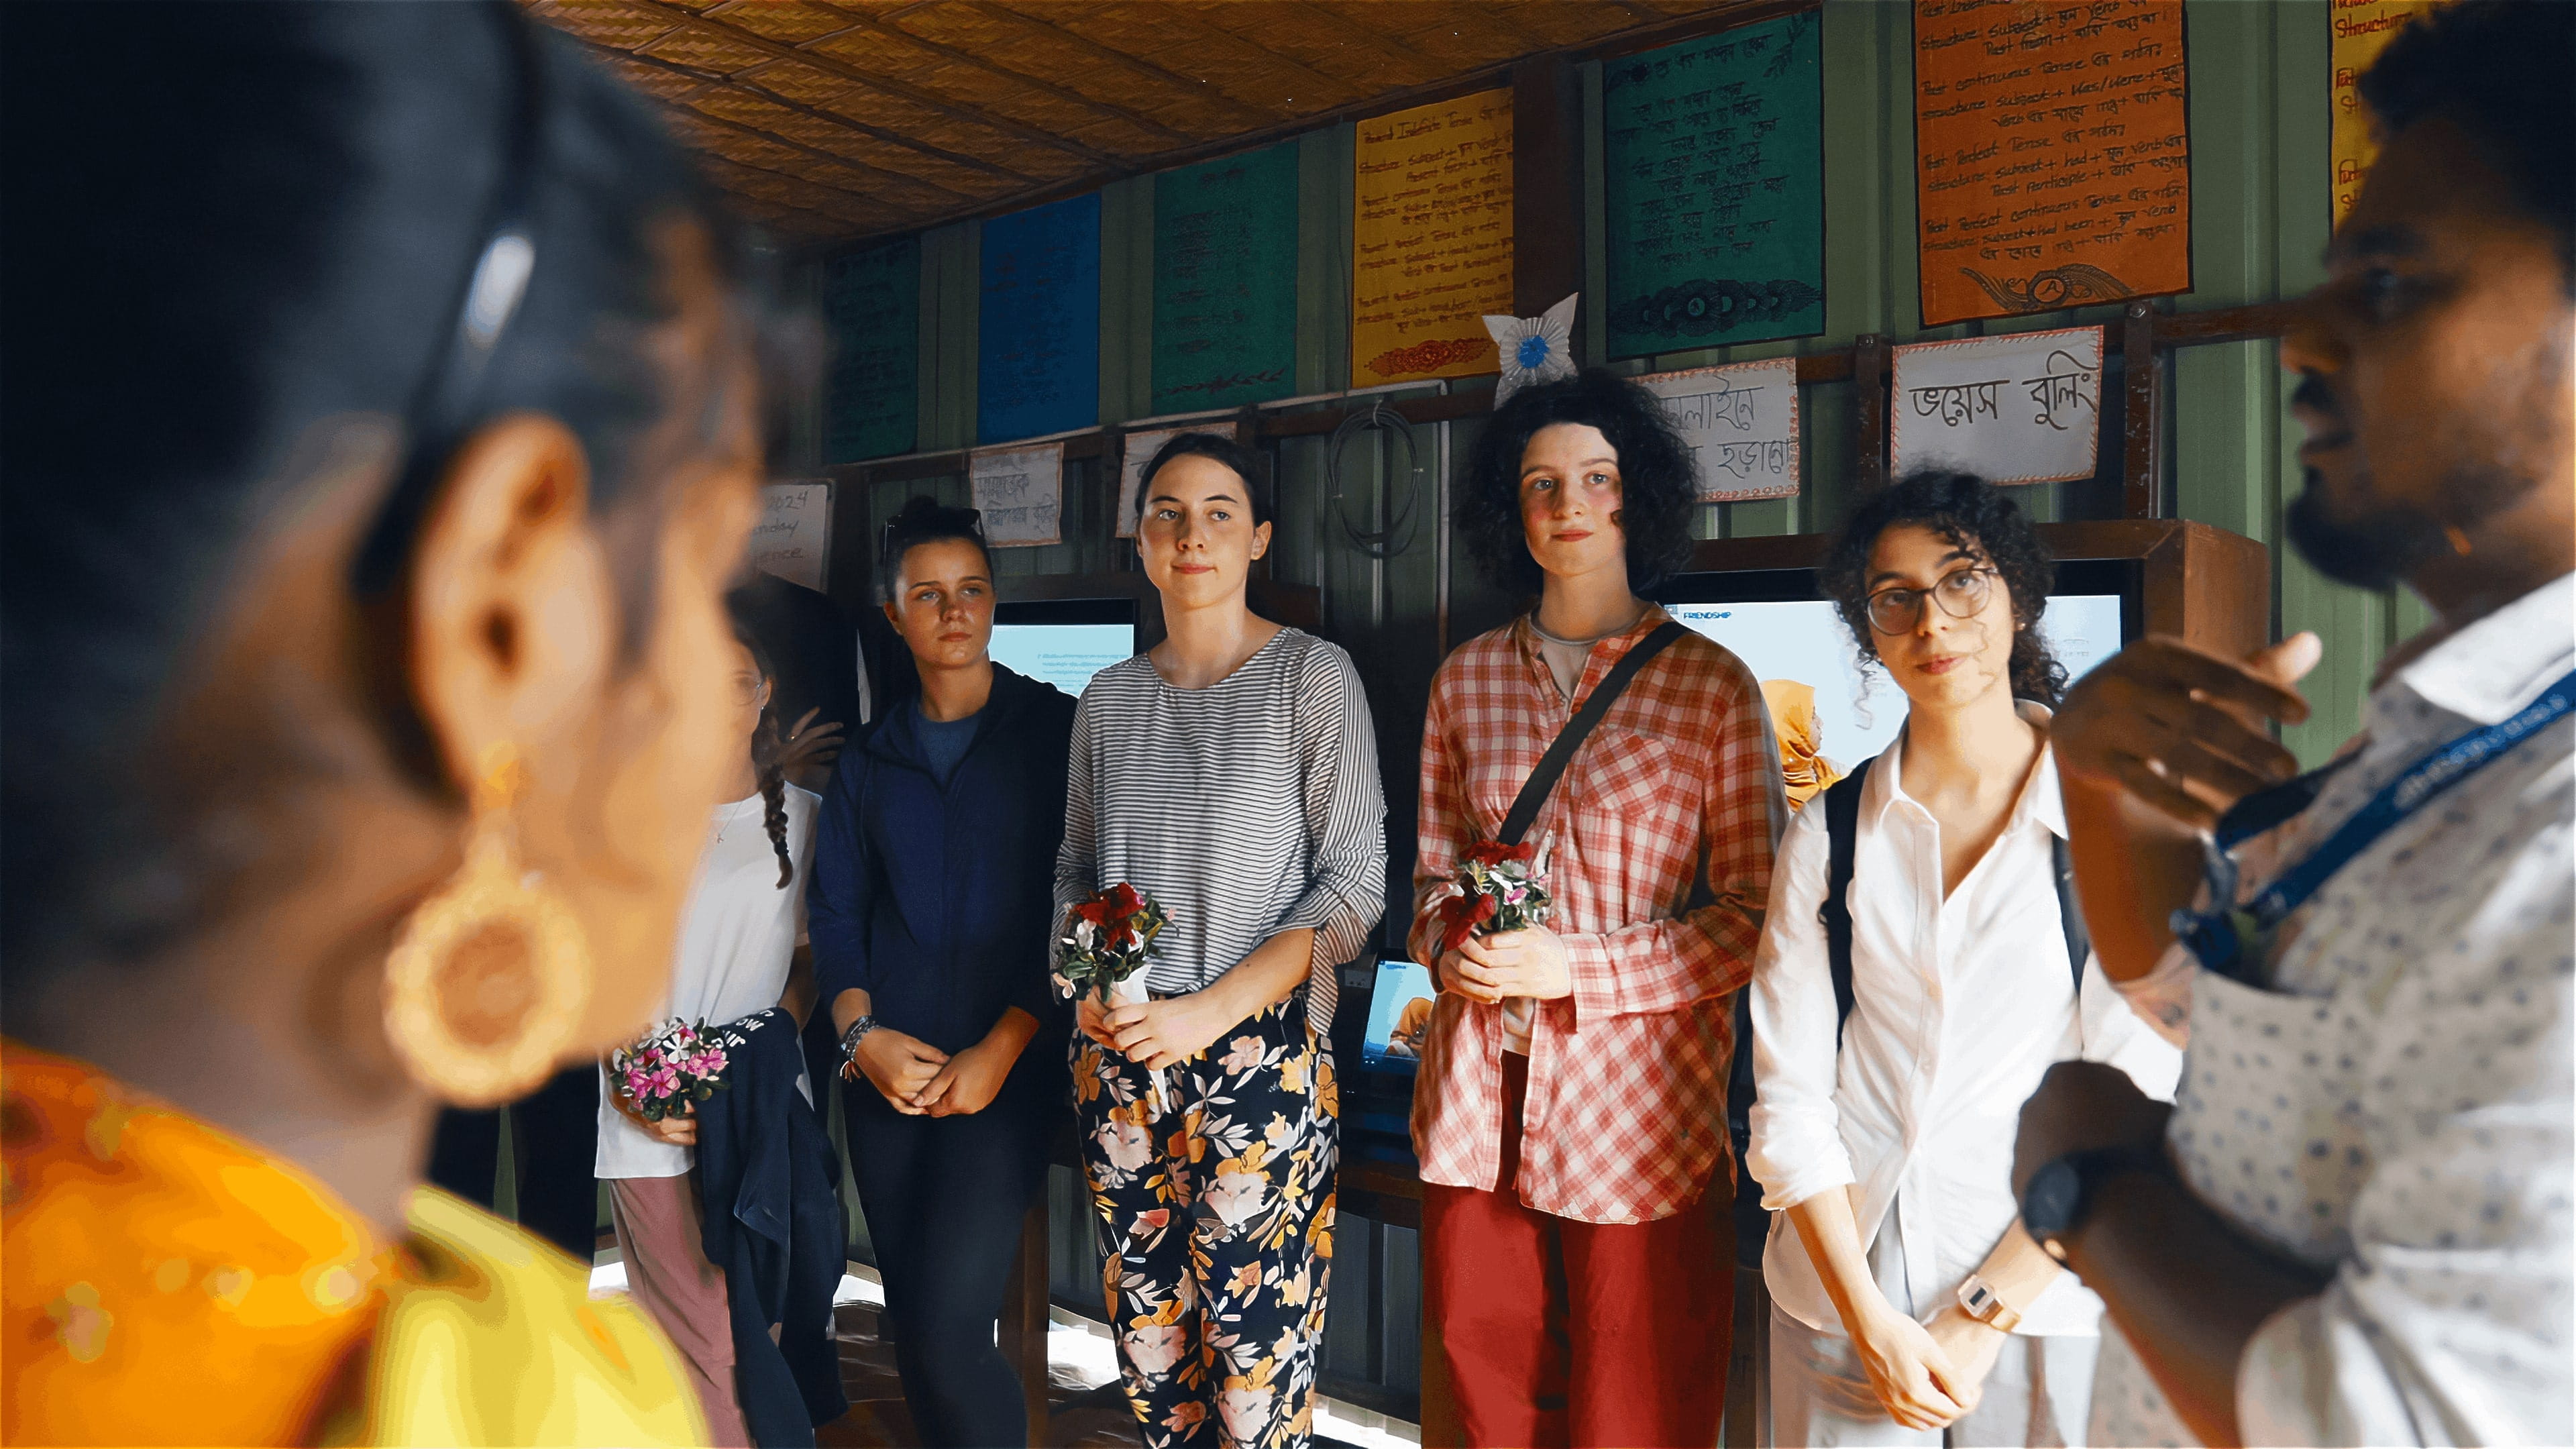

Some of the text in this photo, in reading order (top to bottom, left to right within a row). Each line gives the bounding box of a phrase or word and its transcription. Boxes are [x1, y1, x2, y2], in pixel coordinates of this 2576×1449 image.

[1659, 374, 1765, 431] নলাইনে
[1909, 350, 2099, 431] ভয়েস বুলিং
[1684, 611, 1731, 619] FRIENDSHIP
